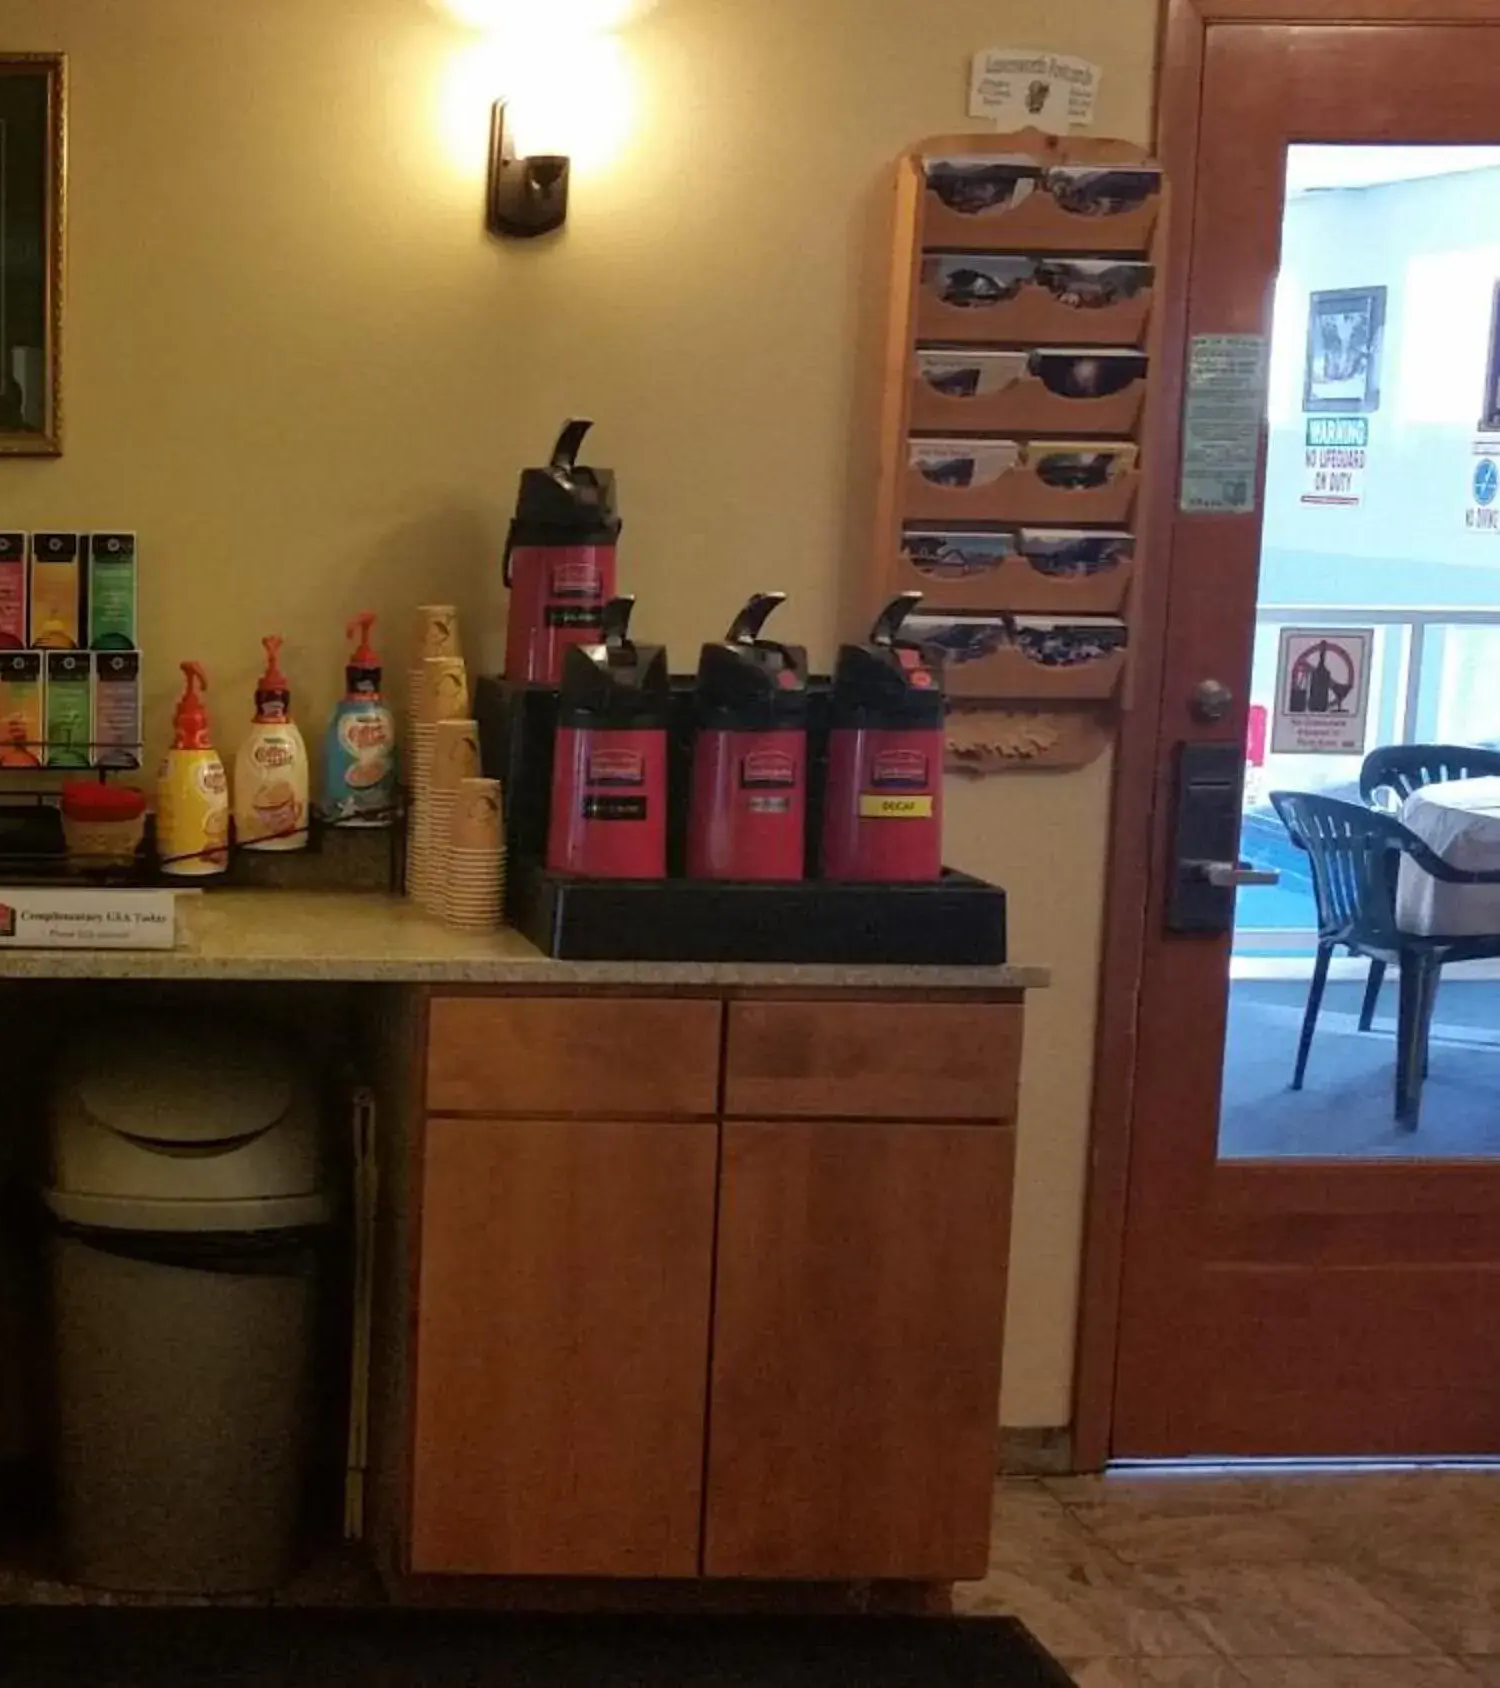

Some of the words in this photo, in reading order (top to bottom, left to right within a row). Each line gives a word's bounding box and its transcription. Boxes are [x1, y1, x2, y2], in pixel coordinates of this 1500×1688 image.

[1310, 420, 1365, 444] WARNING
[1305, 449, 1316, 468] NO
[1319, 449, 1365, 468] LIFEGUARD
[1315, 472, 1326, 491] ON
[1329, 472, 1352, 492] DUTY
